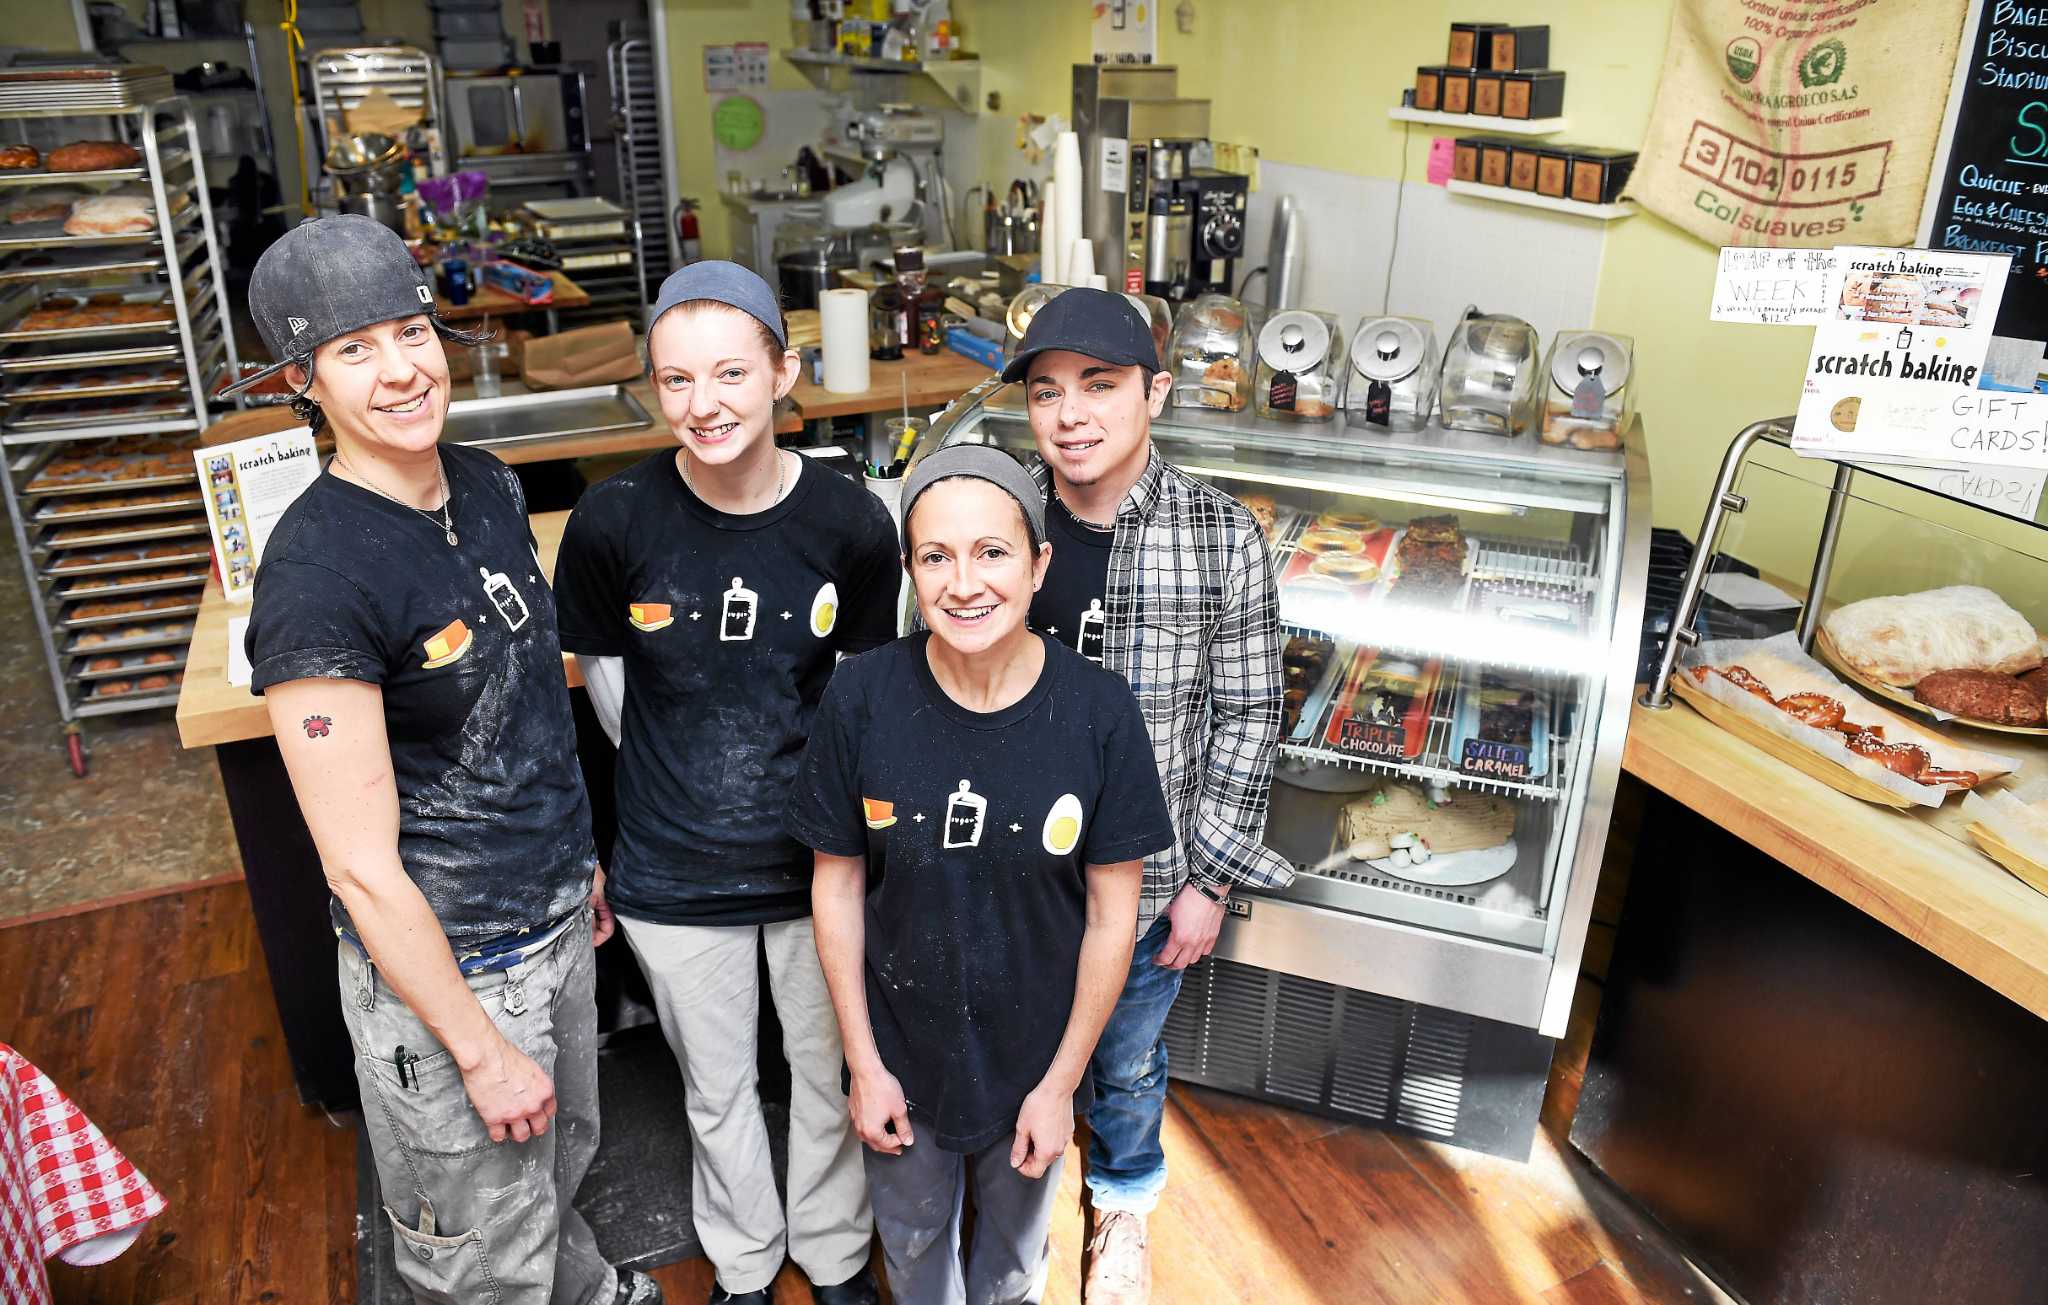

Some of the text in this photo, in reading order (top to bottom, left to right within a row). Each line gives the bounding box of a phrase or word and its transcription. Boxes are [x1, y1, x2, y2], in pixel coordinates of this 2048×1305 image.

[1744, 16, 1772, 34] 100%
[1734, 46, 1754, 57] USDA
[1697, 139, 1720, 165] 3
[1732, 156, 1778, 191] 104
[1791, 162, 1858, 192] 0115
[1804, 252, 1838, 272] the
[1850, 260, 1895, 273] scratch
[1899, 261, 1944, 277] baking
[1728, 279, 1809, 301] WEEK
[1815, 350, 1978, 386] scratch baking
[1952, 395, 2028, 420] GIFT
[239, 446, 311, 471] scratch baking
[1345, 722, 1399, 742] TRIPLE
[1340, 737, 1405, 758] CHOCOLATE
[1466, 741, 1525, 763] SALTED
[1464, 757, 1527, 778] CARAMEL
